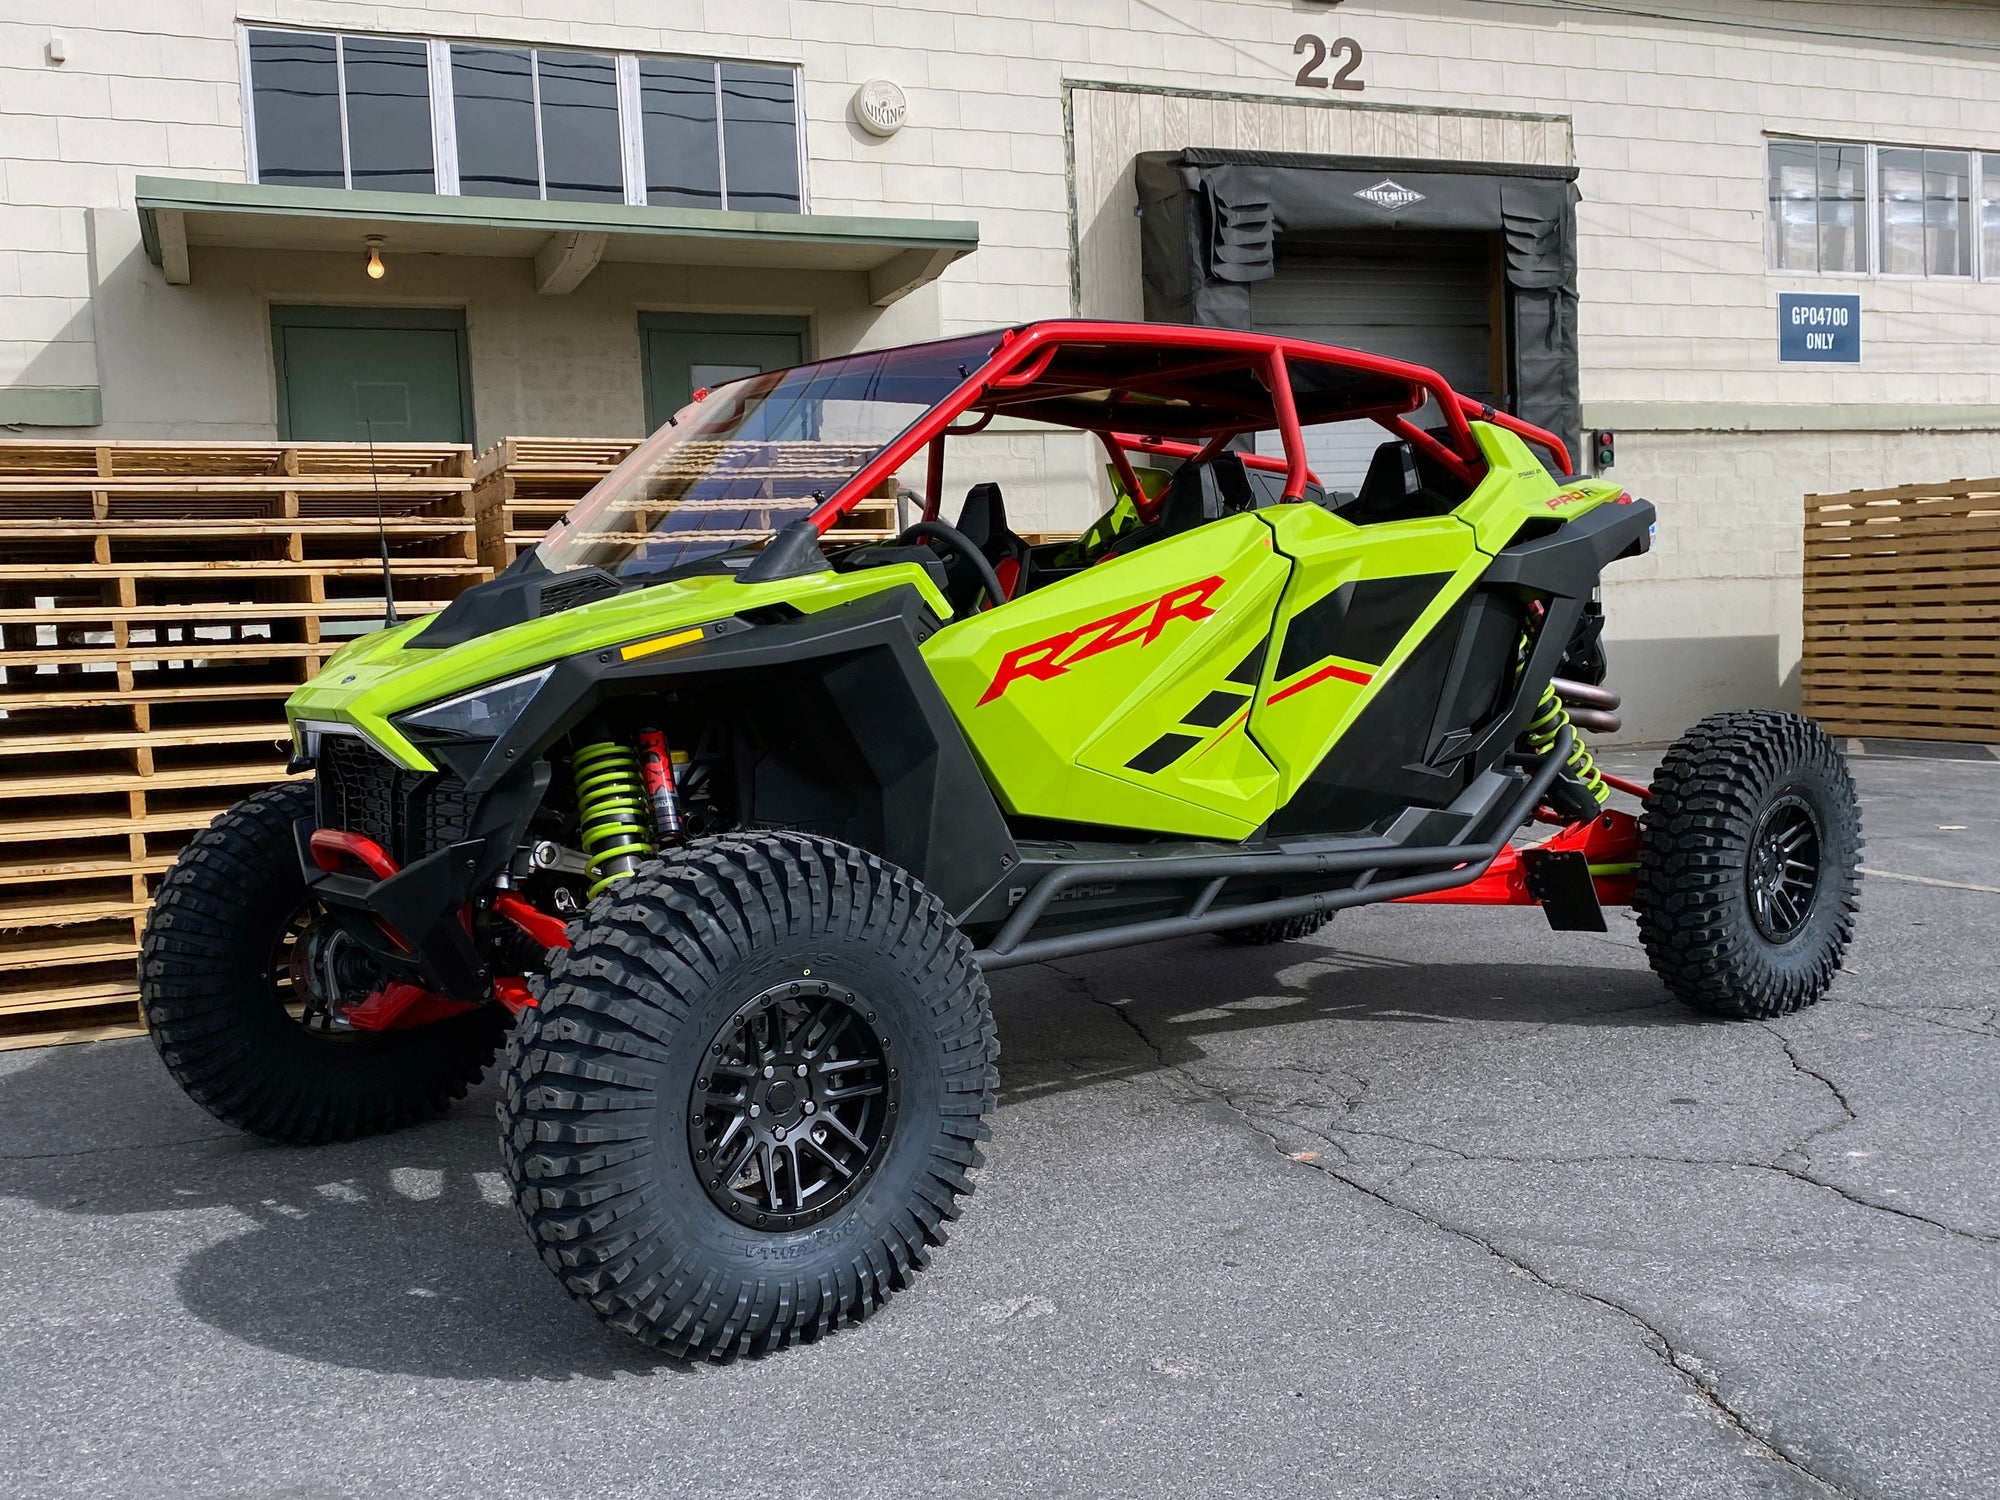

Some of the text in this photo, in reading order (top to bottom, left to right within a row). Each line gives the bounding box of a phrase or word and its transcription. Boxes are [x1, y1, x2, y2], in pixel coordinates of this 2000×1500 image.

[1294, 33, 1364, 91] 22
[865, 101, 905, 124] VIKING
[1806, 332, 1835, 350] ONLY
[1545, 491, 1585, 511] PRO
[974, 575, 1226, 709] RZR
[1008, 883, 1117, 906] PARIS
